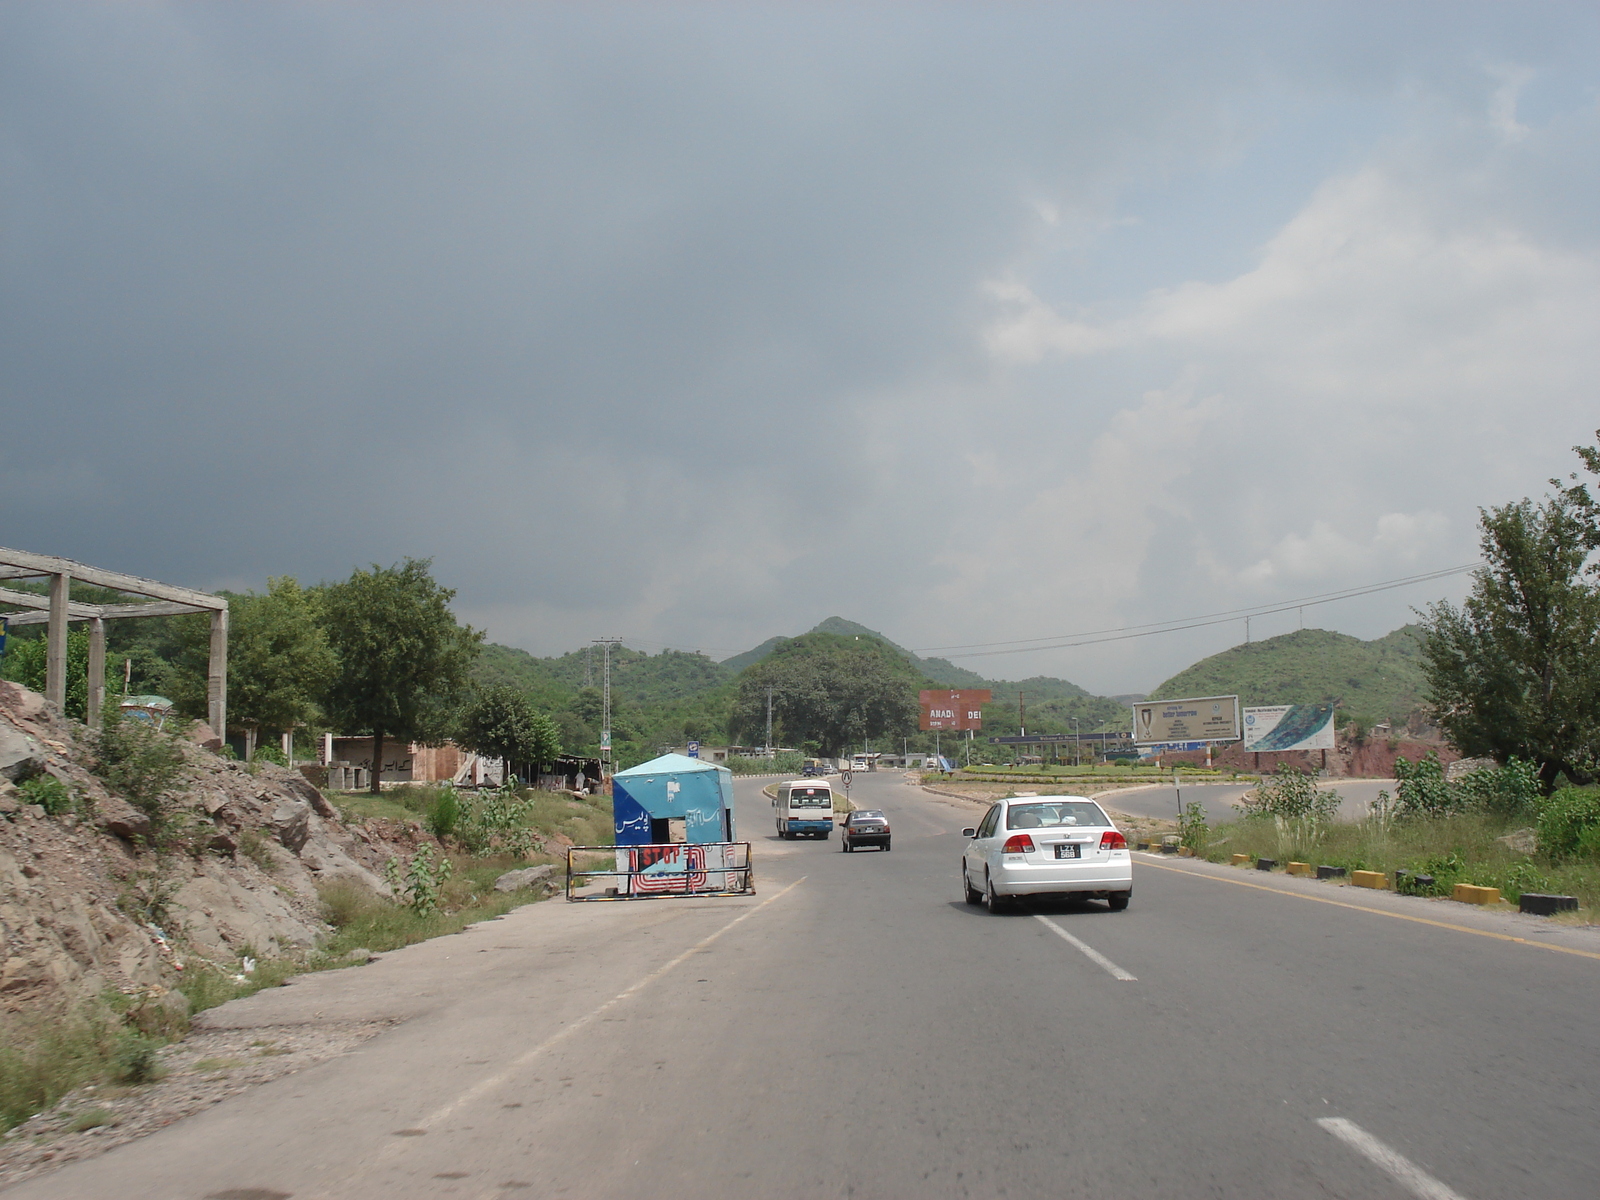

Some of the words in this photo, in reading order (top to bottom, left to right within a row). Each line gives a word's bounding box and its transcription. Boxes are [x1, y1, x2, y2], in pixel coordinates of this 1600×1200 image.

[615, 811, 649, 834] پولیس
[642, 847, 681, 866] STOP
[1059, 844, 1075, 852] LZX
